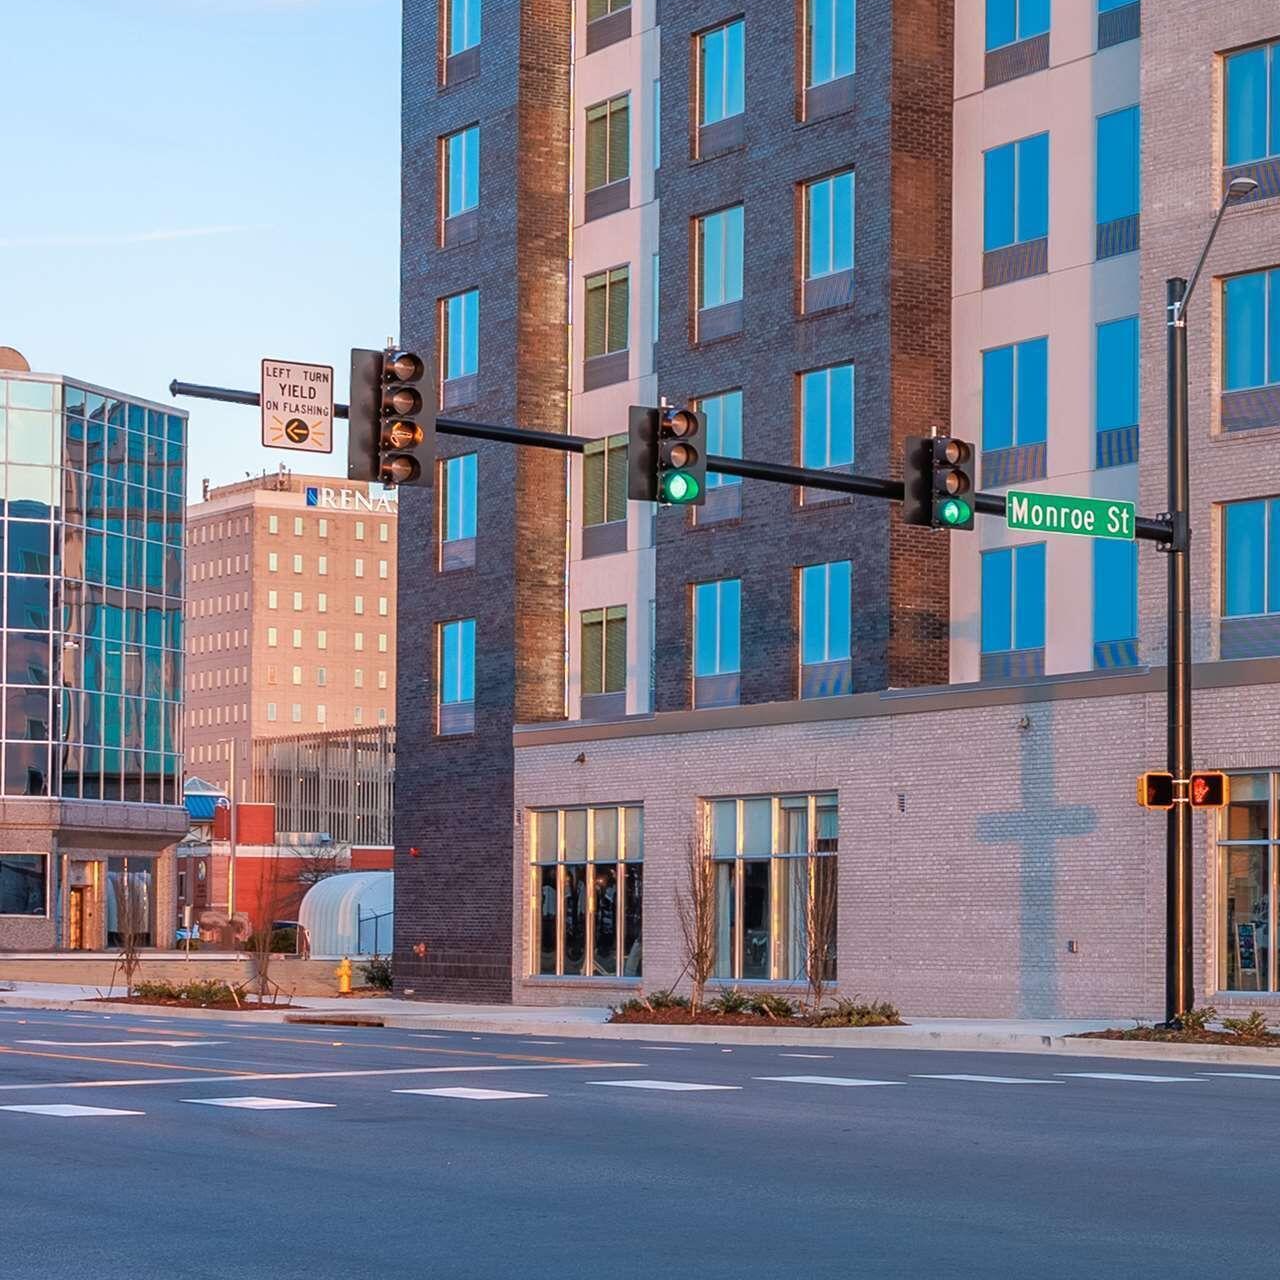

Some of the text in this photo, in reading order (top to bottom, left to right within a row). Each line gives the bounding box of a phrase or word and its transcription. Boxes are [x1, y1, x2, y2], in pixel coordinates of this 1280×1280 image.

[266, 367, 329, 383] LEFT TURN
[279, 383, 316, 400] YIELD
[266, 400, 329, 417] ON FLASHING
[321, 487, 398, 513] RENA
[1012, 496, 1129, 534] Monroe St
